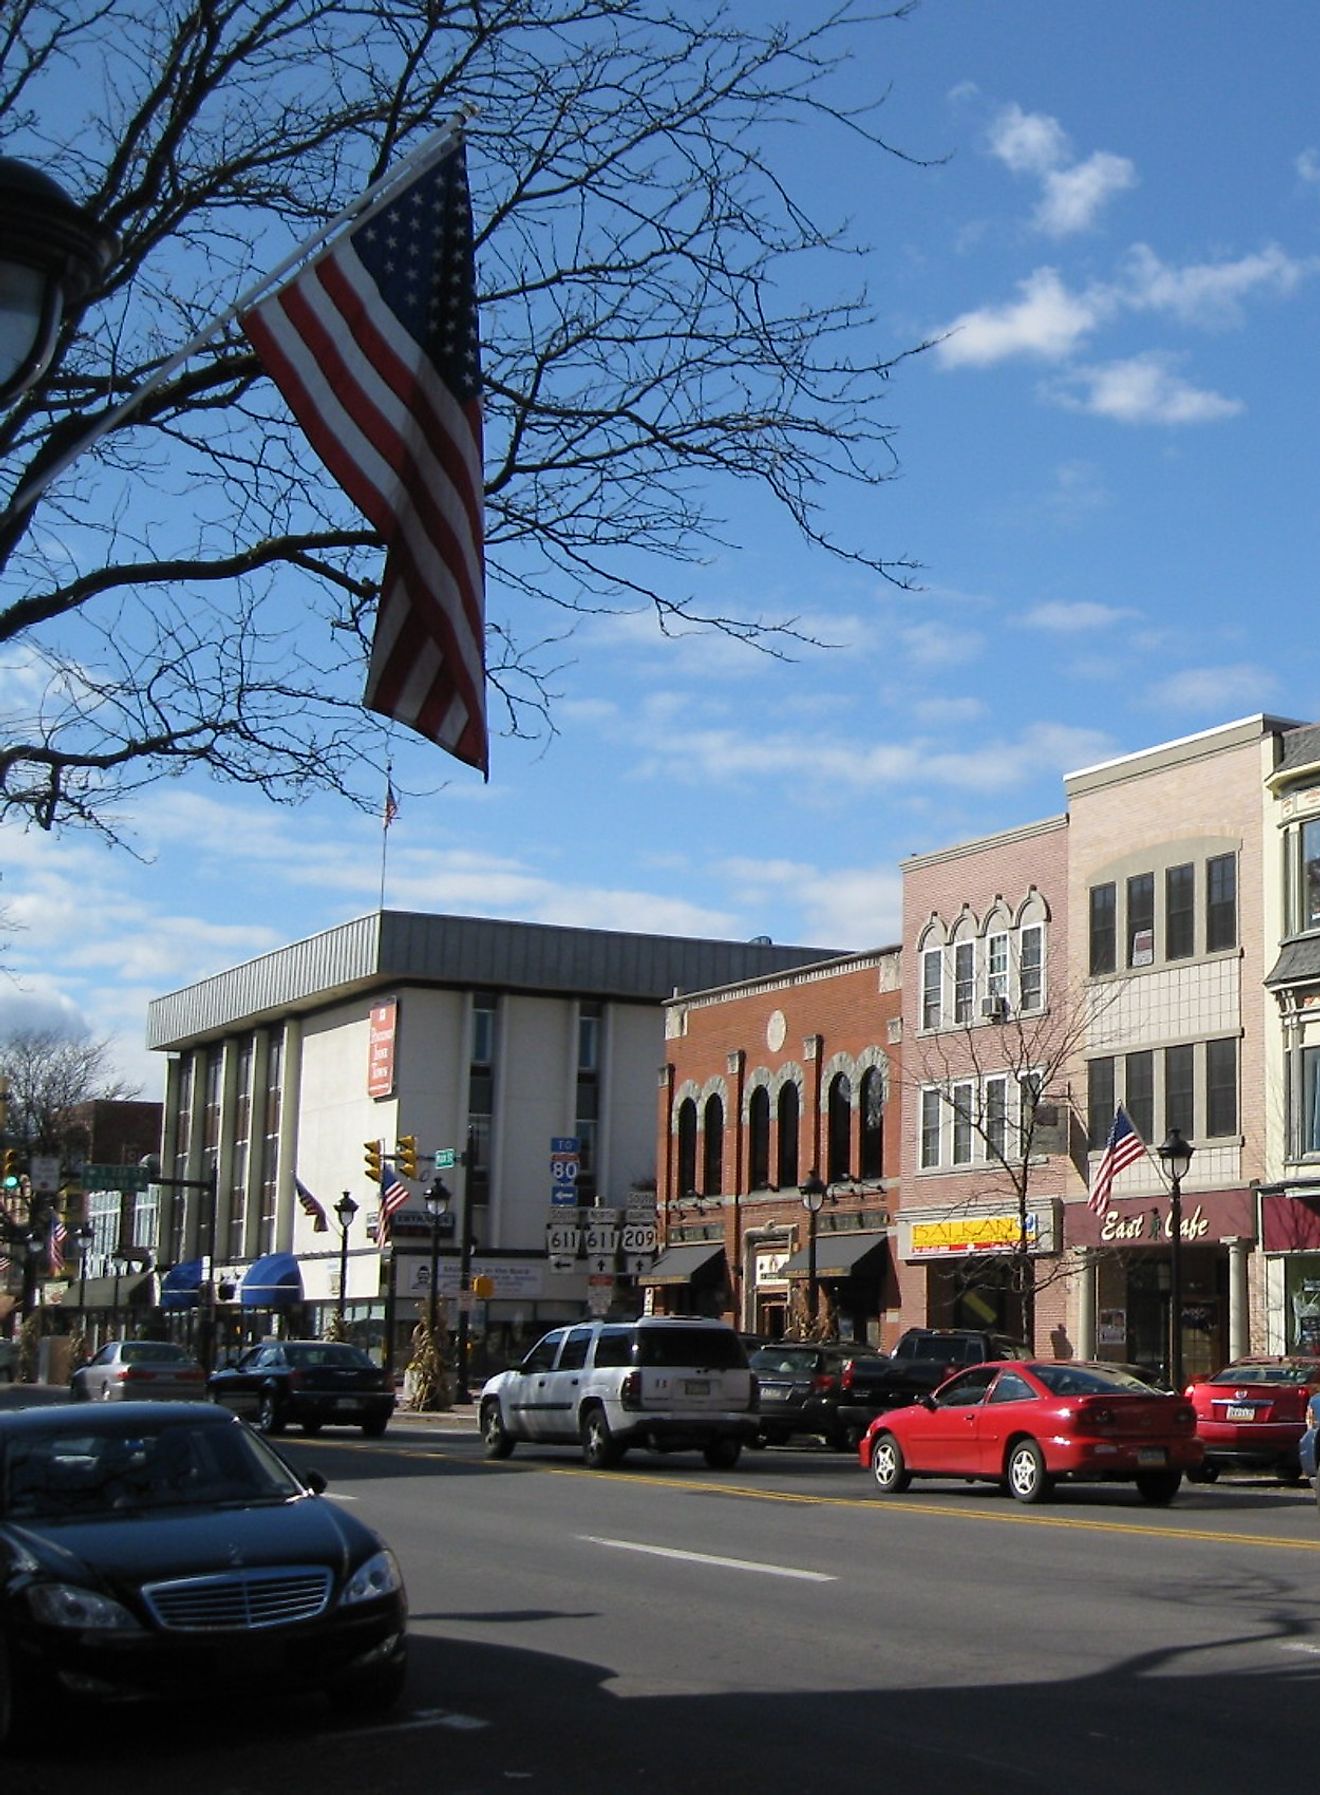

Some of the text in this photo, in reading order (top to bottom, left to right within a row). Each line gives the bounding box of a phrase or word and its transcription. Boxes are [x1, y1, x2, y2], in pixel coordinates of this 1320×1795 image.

[553, 1162, 577, 1179] 80
[1101, 1210, 1145, 1241] East
[551, 1232, 577, 1248] 611
[587, 1231, 615, 1248] 611
[625, 1230, 656, 1248] 209
